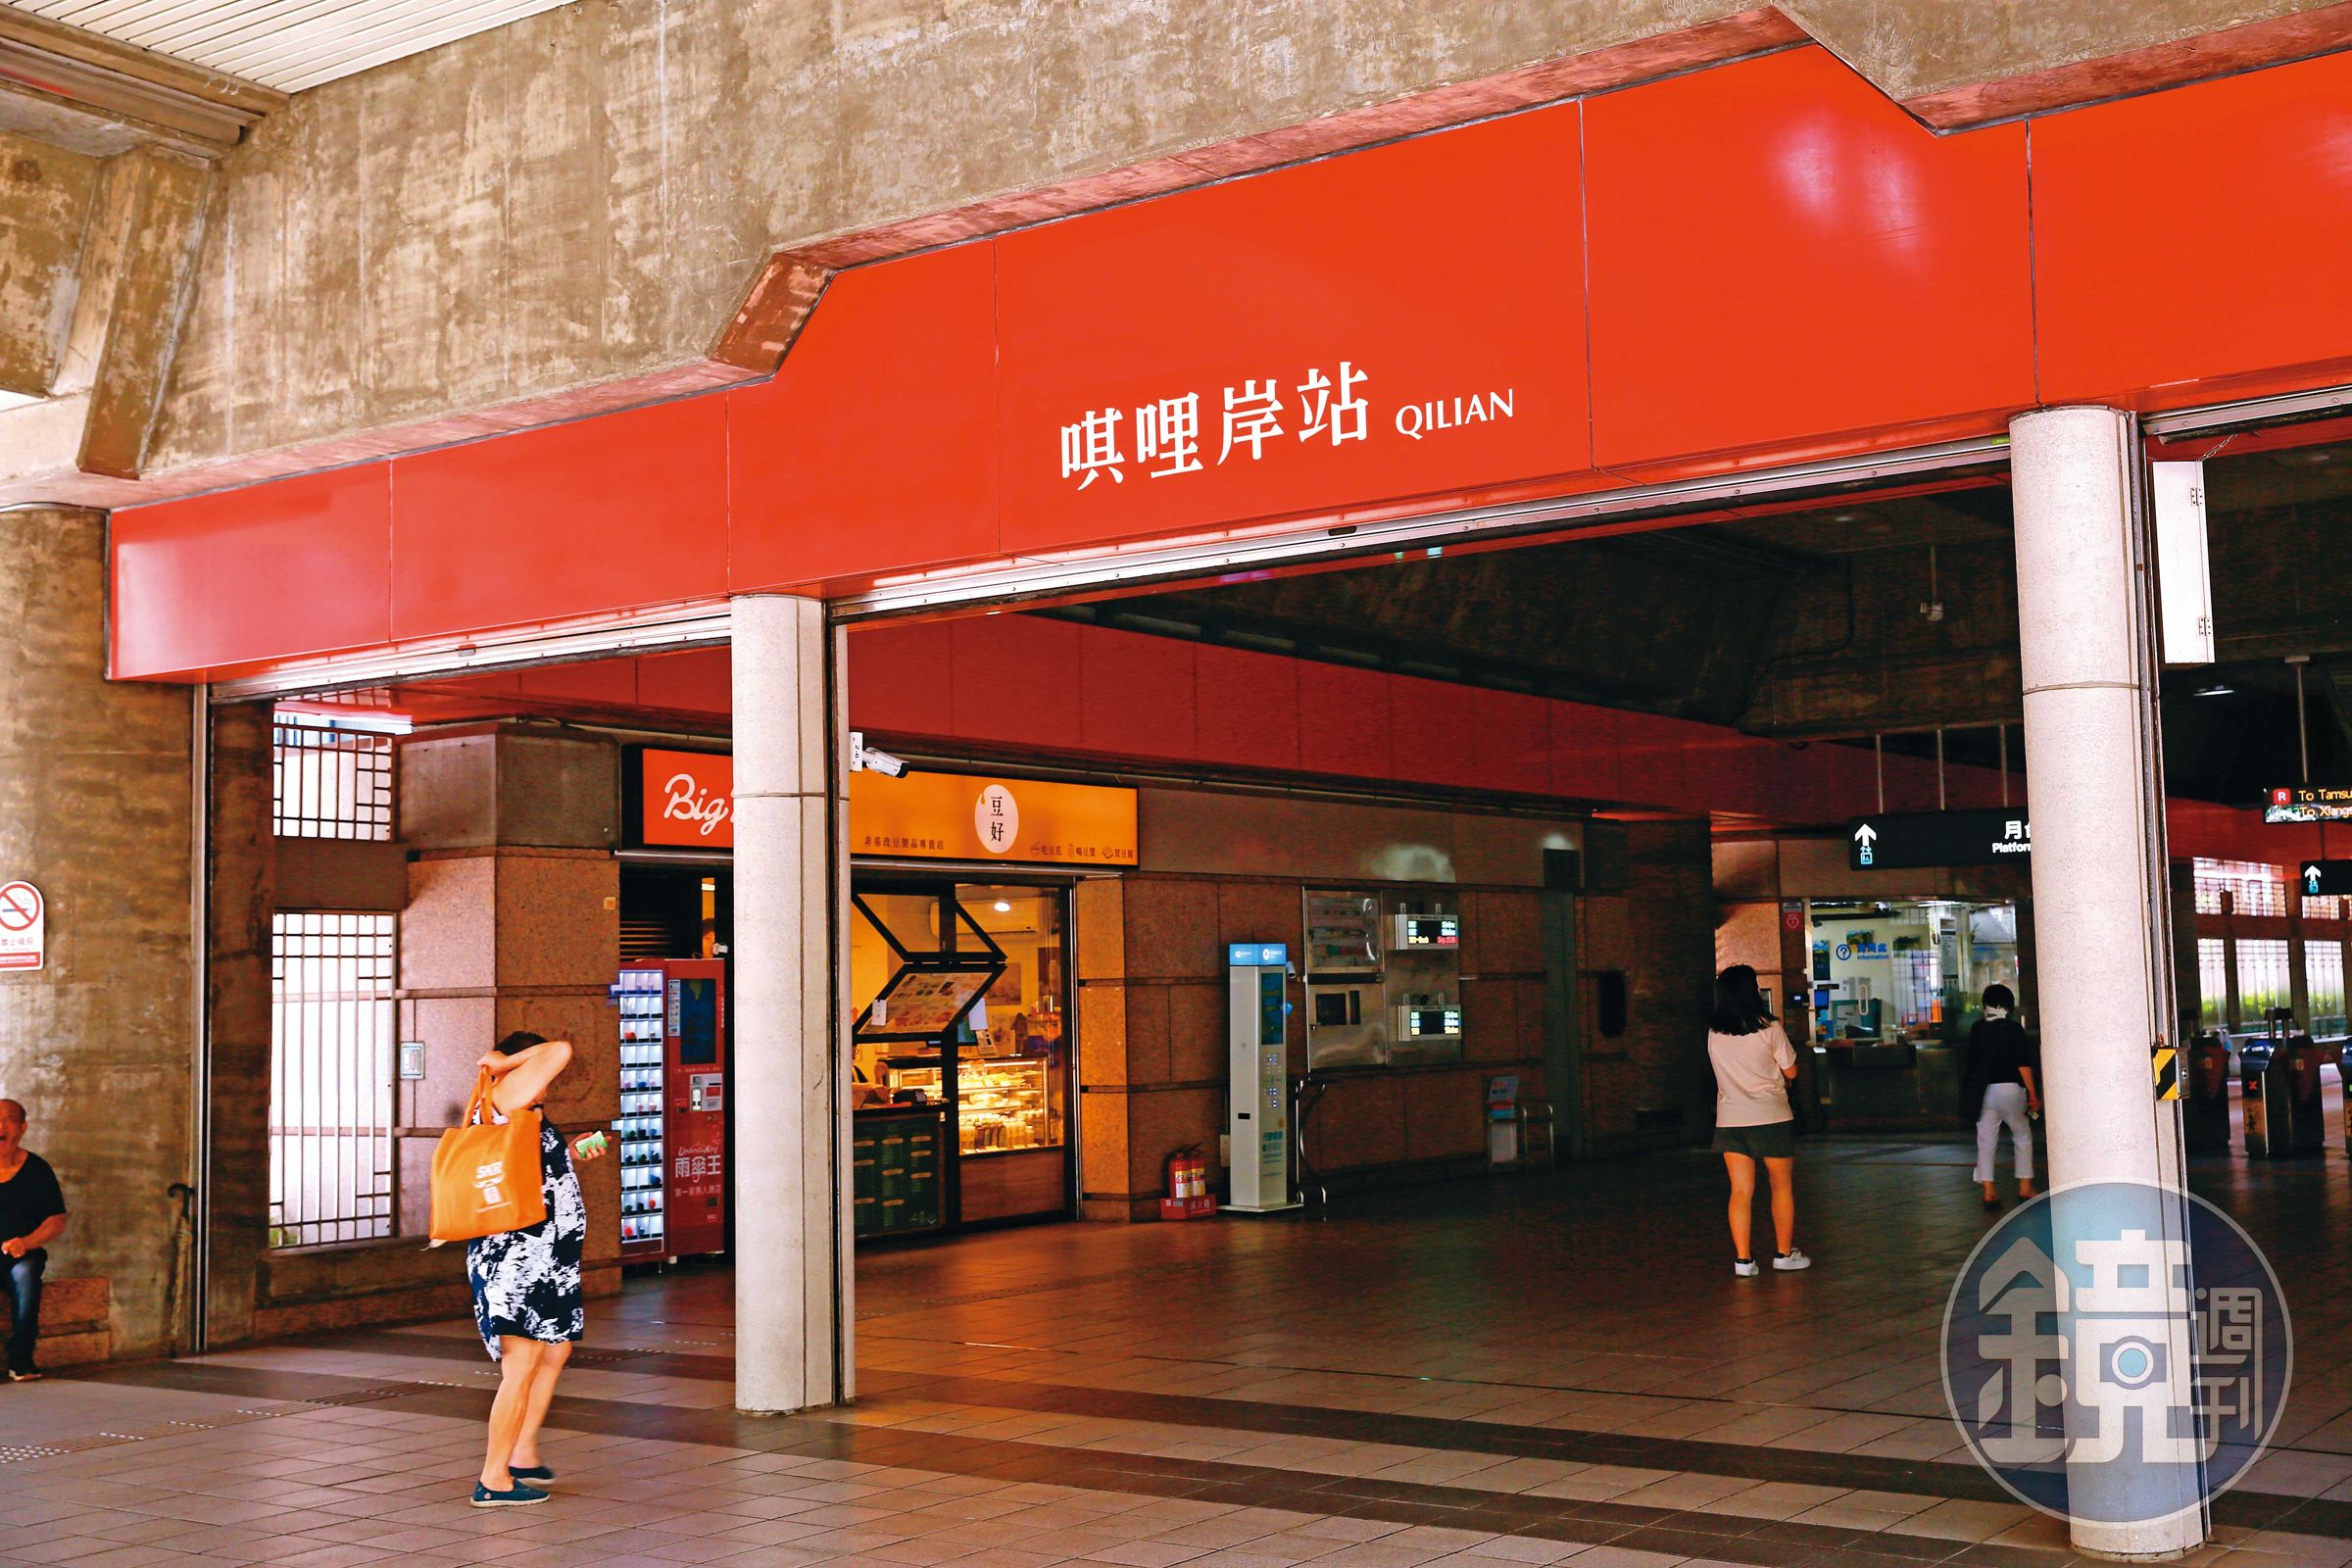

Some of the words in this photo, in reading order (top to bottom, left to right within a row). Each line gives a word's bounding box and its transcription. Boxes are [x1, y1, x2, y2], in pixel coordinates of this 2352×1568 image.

[1060, 361, 1370, 491] 唭哩岸站
[1395, 388, 1515, 440] QILIAN
[2278, 792, 2286, 802] R
[2298, 790, 2314, 802] To
[990, 796, 1004, 843] 豆好
[1991, 842, 2031, 854] Platfor
[674, 1154, 721, 1183] 雨傘王
